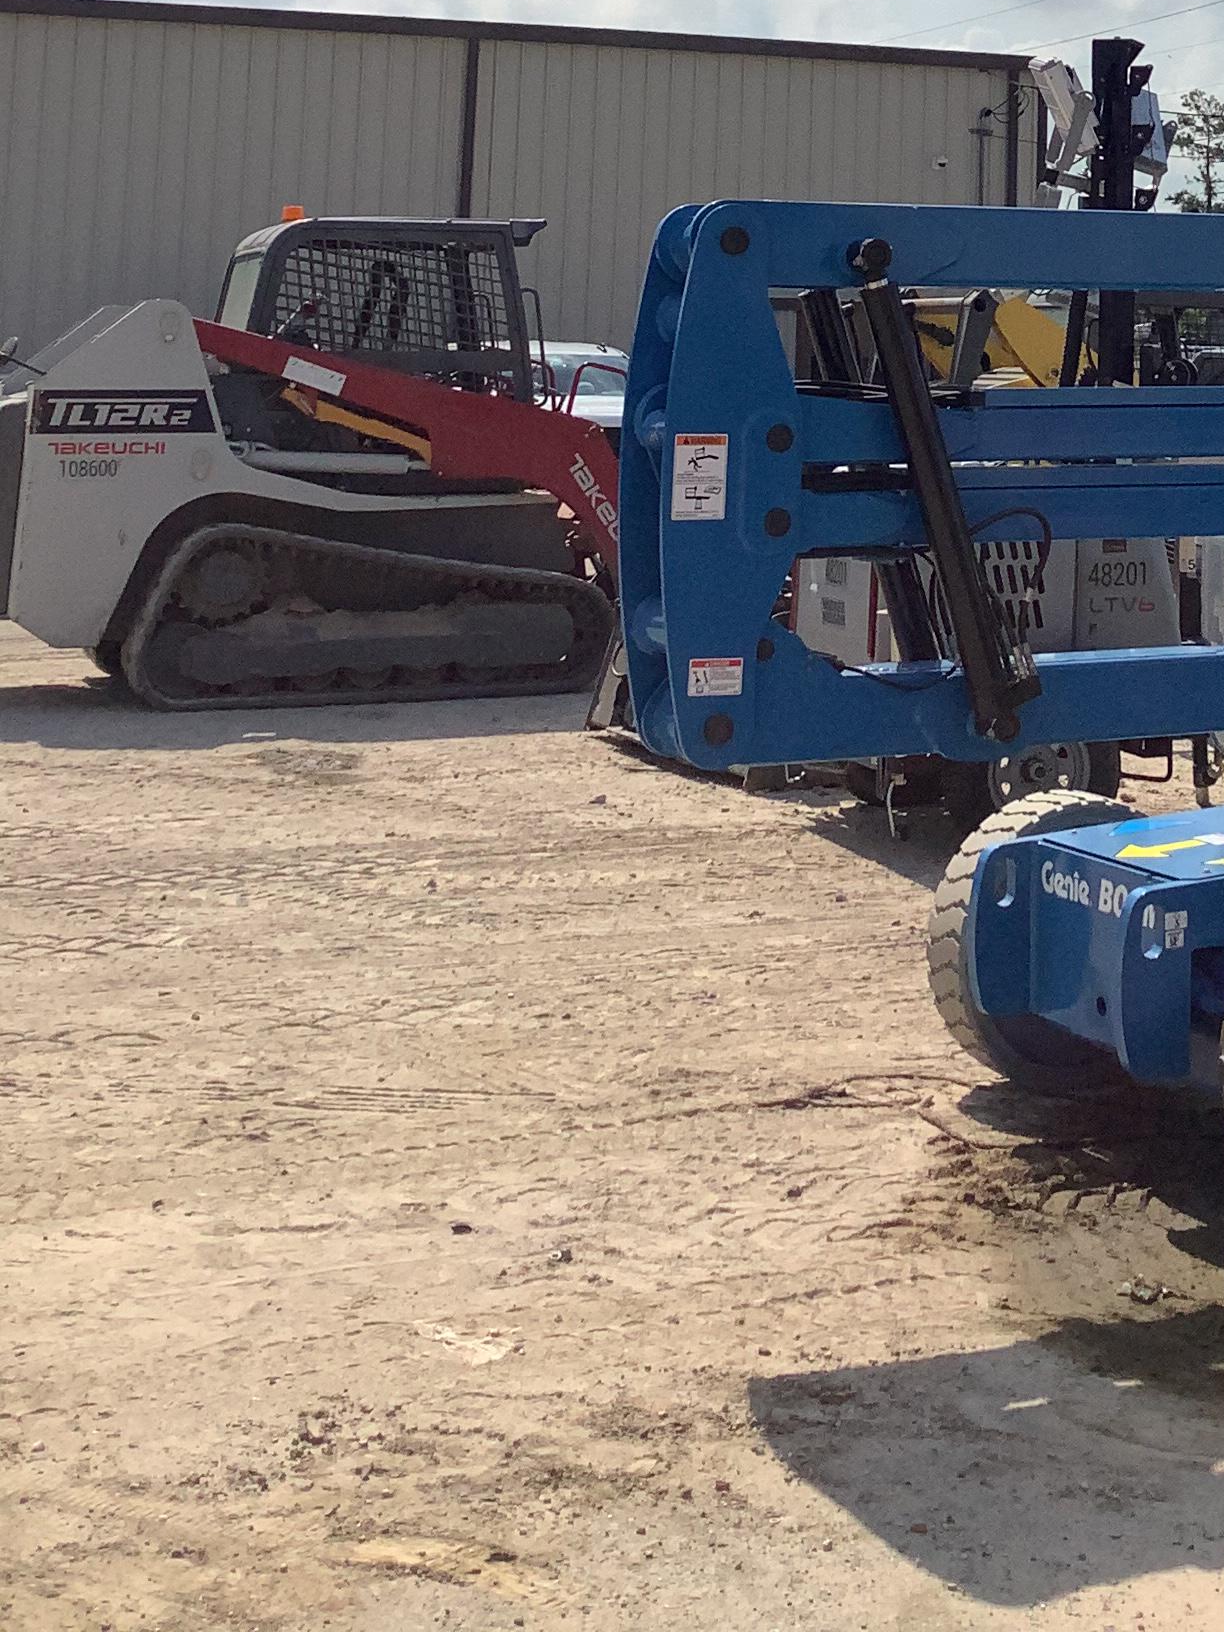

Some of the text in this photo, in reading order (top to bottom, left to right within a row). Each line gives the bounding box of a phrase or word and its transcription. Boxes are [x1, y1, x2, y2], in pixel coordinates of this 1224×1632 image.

[47, 397, 199, 427] TL12R2
[59, 458, 119, 479] 108600
[1088, 561, 1147, 587] 48201
[1041, 860, 1090, 905] Genie
